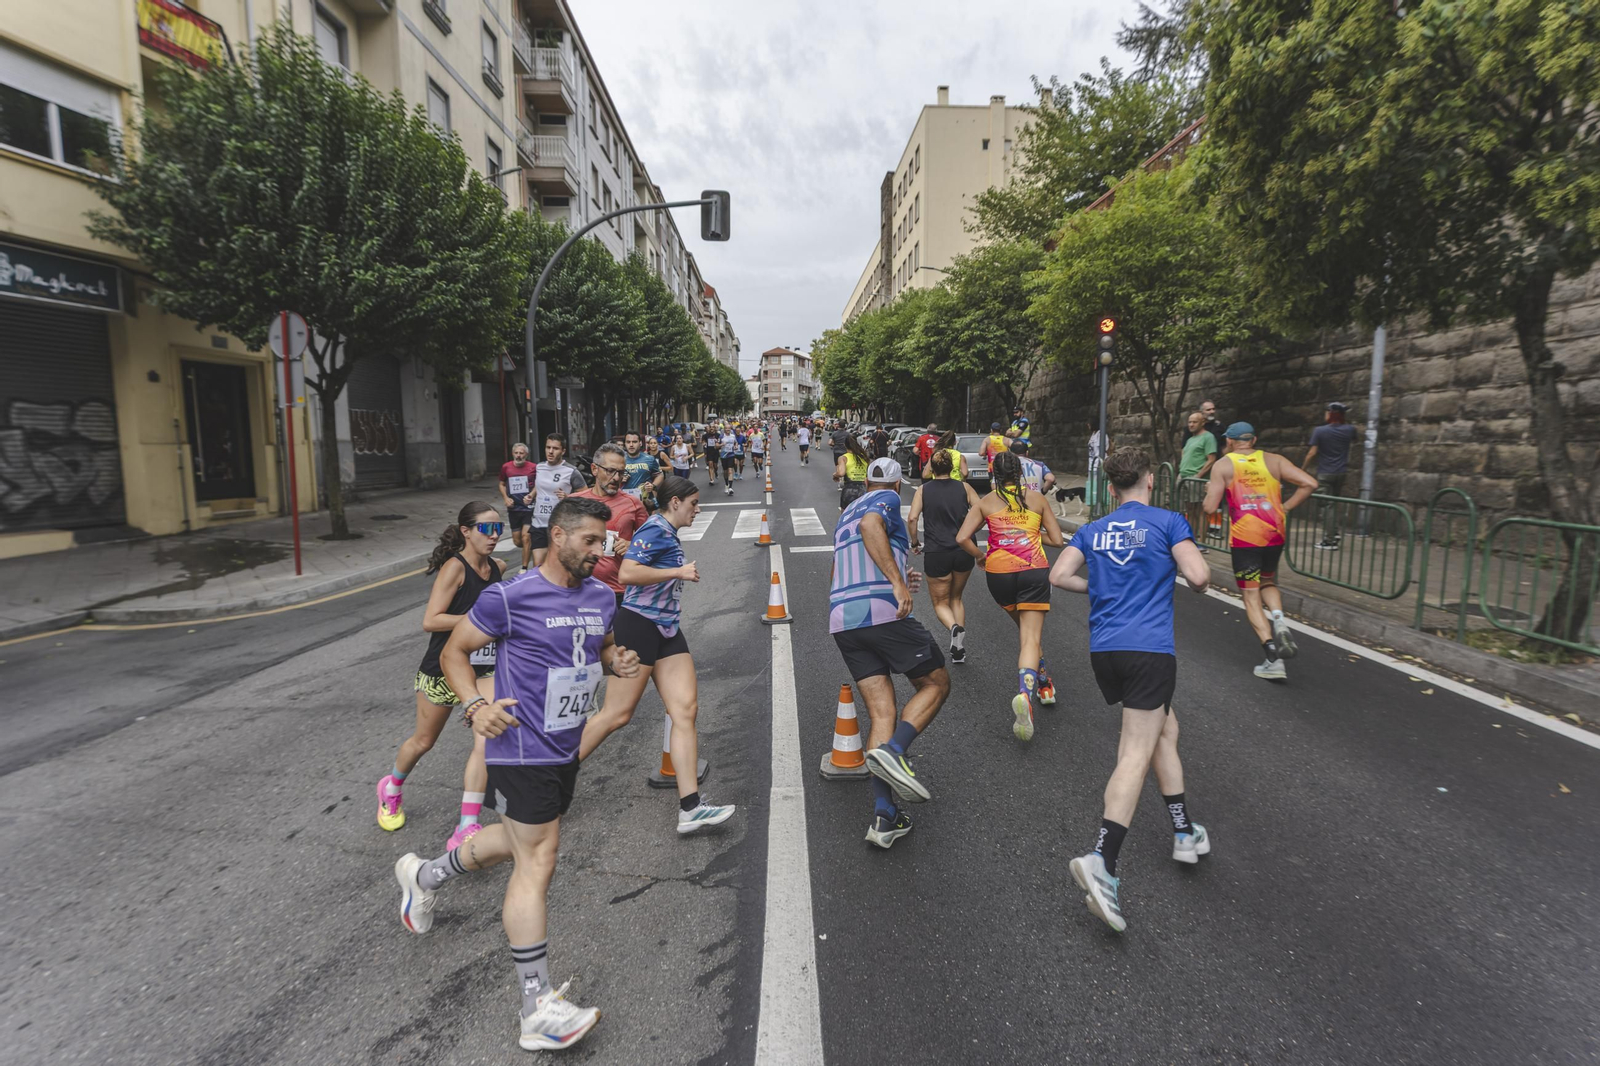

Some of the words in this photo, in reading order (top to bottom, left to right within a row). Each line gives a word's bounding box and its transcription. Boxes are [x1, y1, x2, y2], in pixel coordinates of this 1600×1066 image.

[553, 474, 561, 482] S
[557, 692, 590, 718] 242
[1168, 803, 1188, 829] PACER
